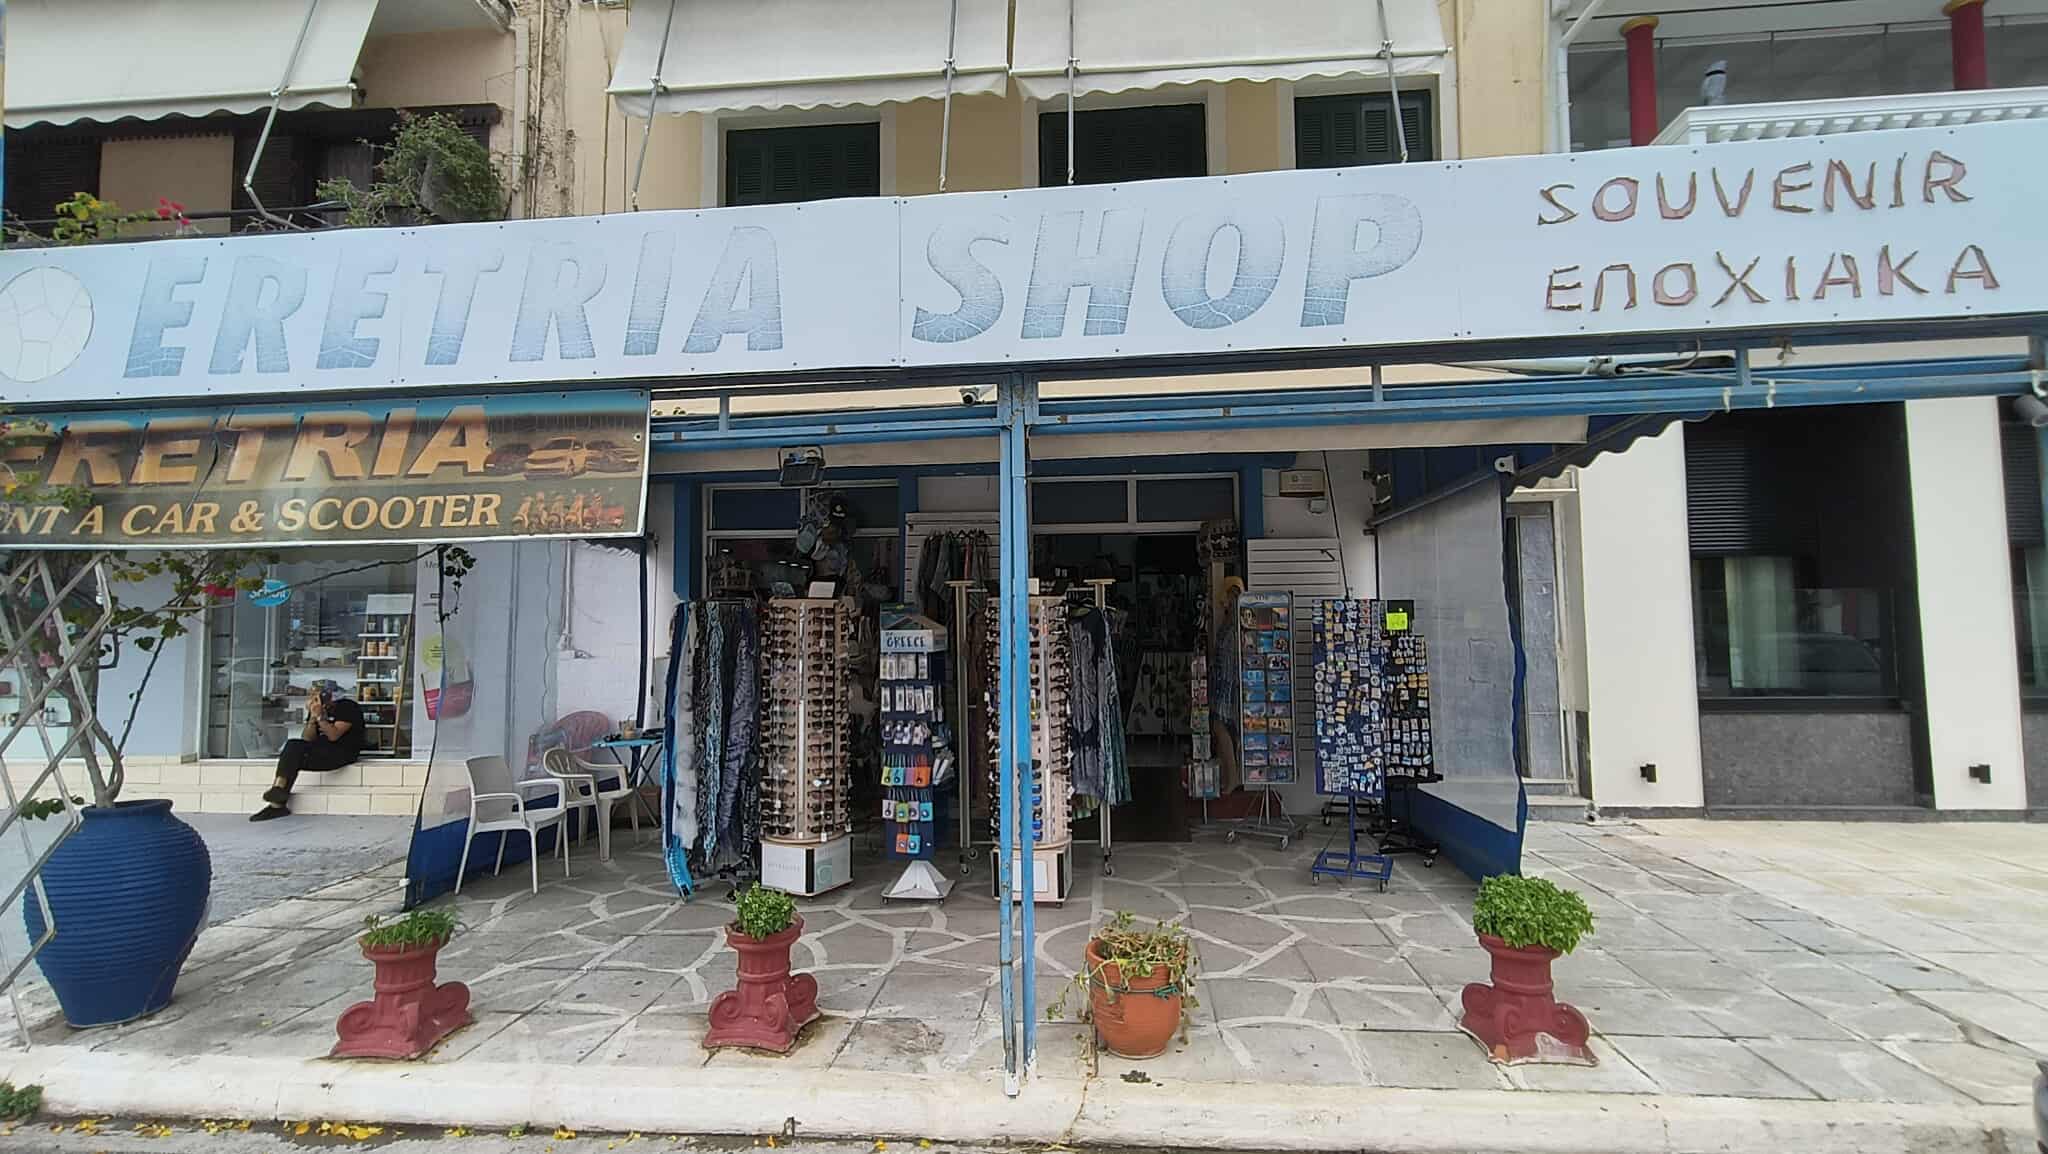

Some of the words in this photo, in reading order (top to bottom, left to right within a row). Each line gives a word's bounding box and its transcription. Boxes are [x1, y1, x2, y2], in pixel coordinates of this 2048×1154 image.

[1537, 150, 1974, 226] SOUVENIR
[122, 226, 784, 379] ERETRIA
[911, 193, 1423, 344] SHOP
[1545, 244, 2000, 312] ΕΠΟΧΙΑΚΑ
[71, 504, 104, 535] A
[121, 500, 219, 537] CAR
[230, 500, 265, 533] &
[277, 493, 501, 532] SCOOTER
